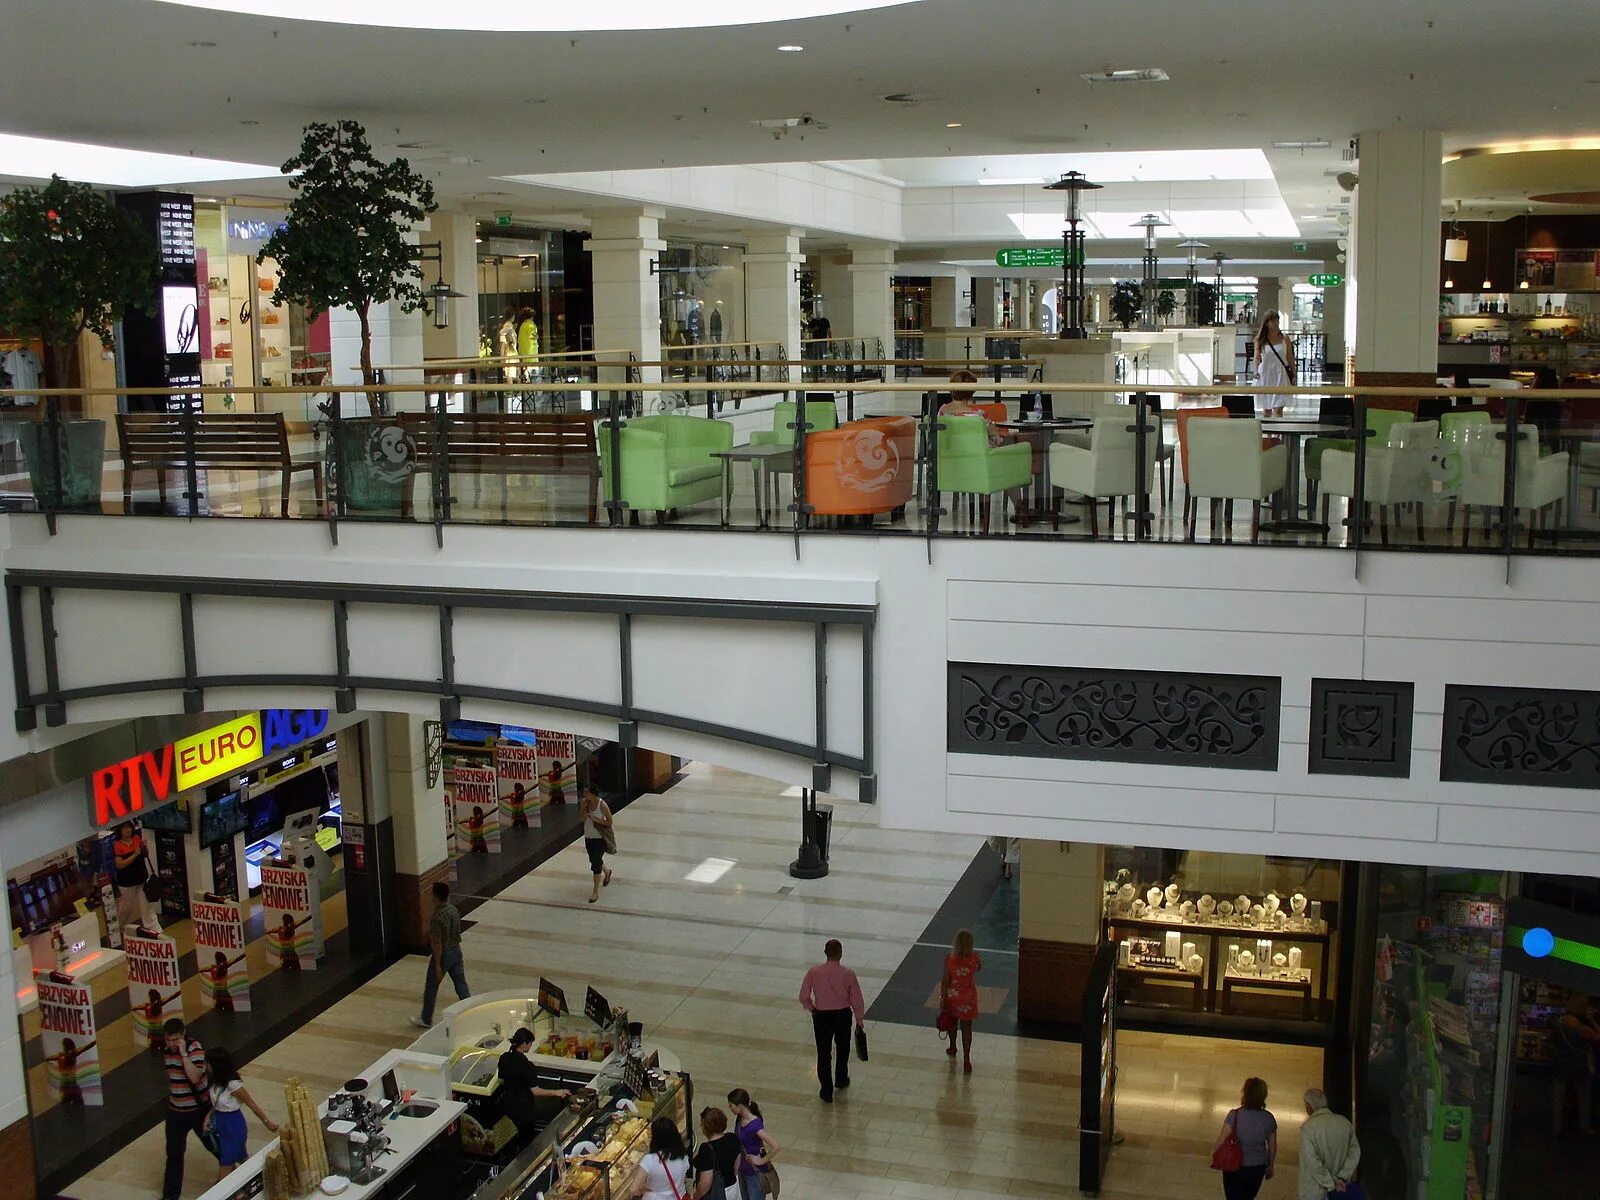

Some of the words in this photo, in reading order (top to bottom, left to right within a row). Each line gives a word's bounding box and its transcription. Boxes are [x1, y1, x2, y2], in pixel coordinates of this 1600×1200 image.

[1001, 251, 1008, 265] 1
[1311, 275, 1318, 285] 1
[326, 740, 336, 748] SON
[92, 743, 175, 826] RTV
[181, 725, 256, 774] EURO
[264, 709, 328, 755] AGD
